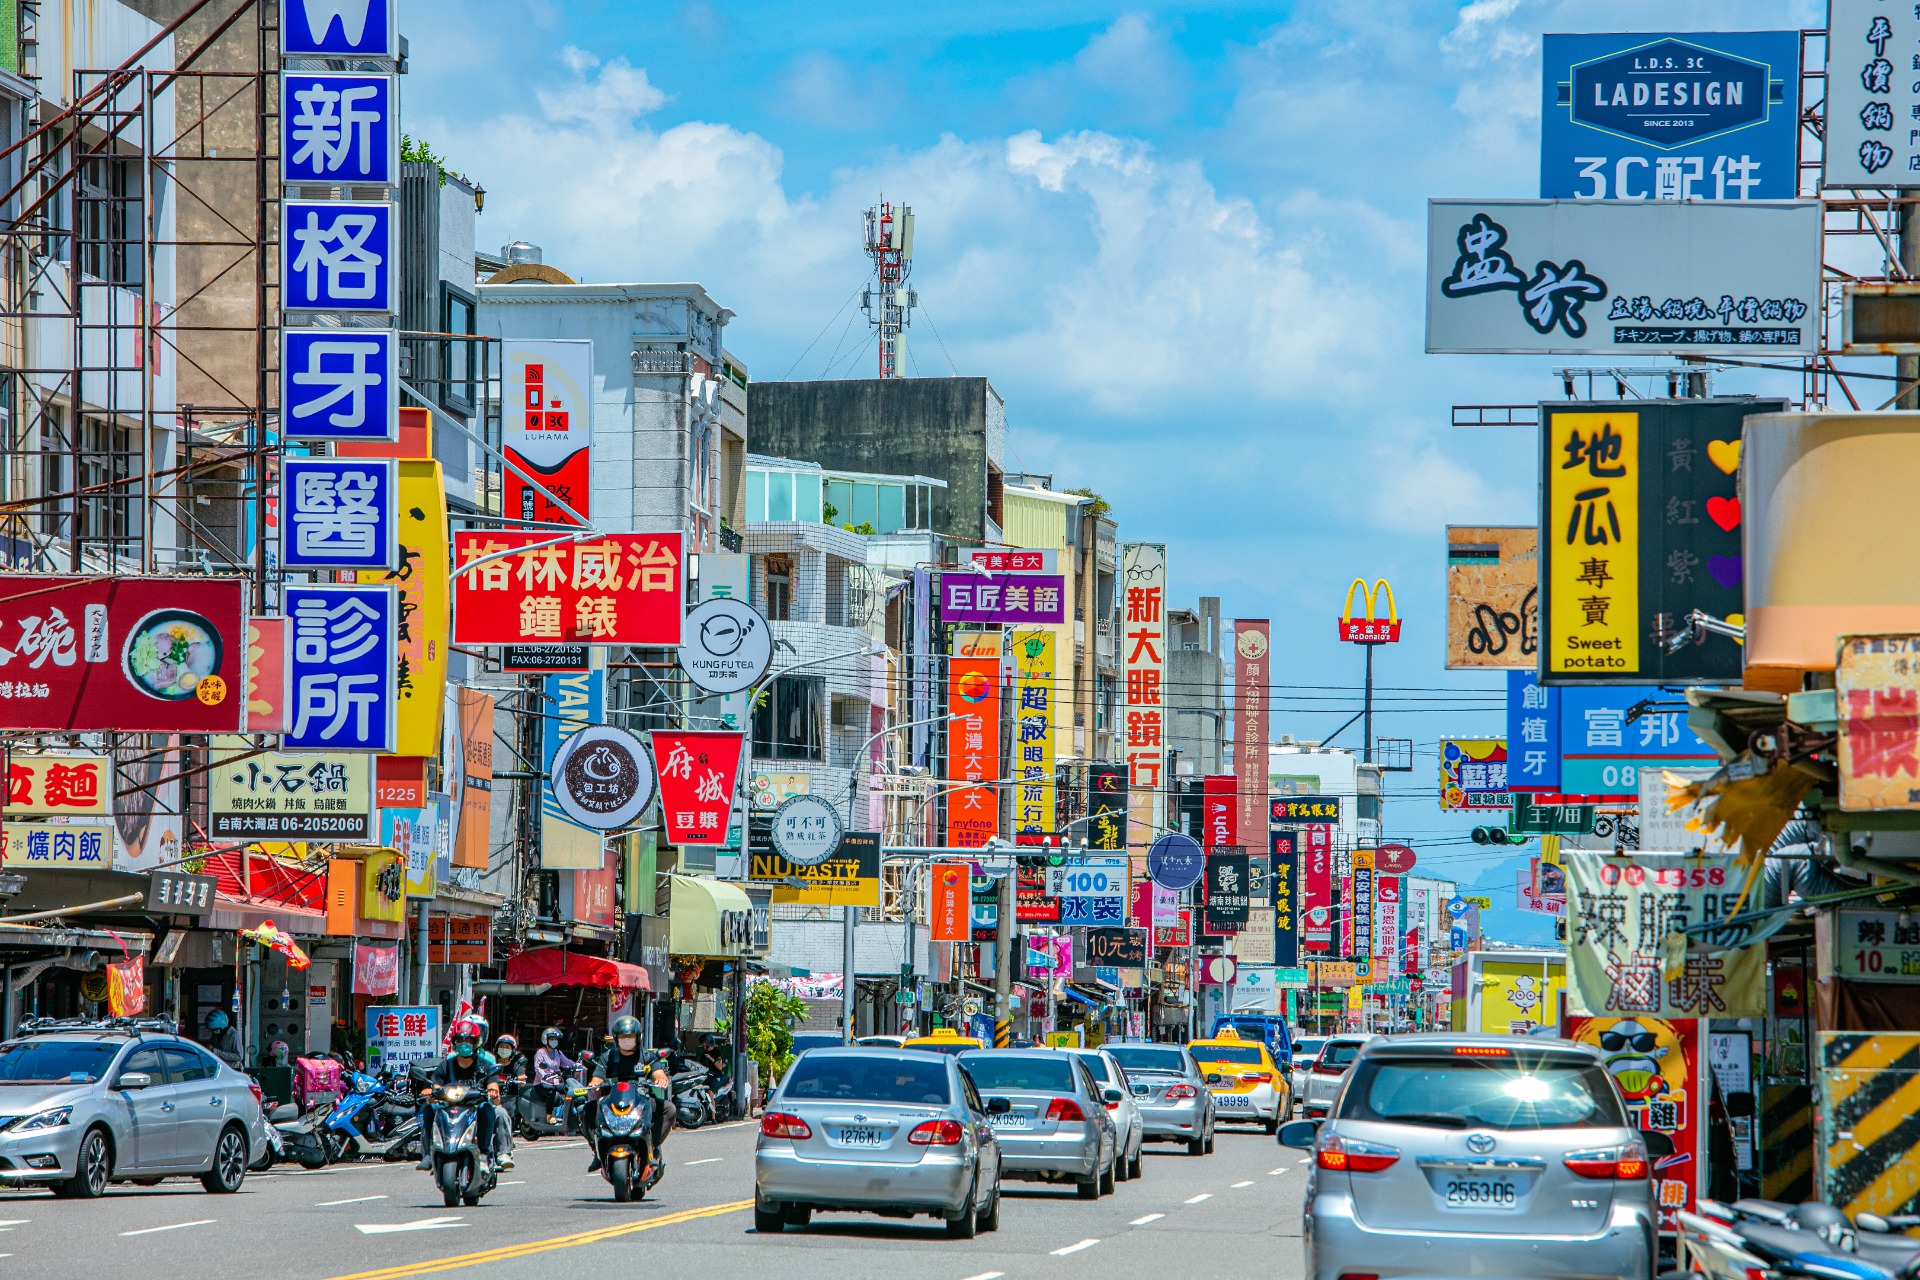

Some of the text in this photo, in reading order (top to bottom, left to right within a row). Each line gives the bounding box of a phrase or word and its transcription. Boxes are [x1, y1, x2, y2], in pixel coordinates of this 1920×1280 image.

[1634, 57, 1704, 69] L.D.S. 3C
[1595, 82, 1743, 107] LADESIGN
[1860, 16, 1893, 174] 平價鍋物
[1574, 156, 1762, 199] 3C配件
[292, 84, 382, 742] 新格牙醫診所
[1562, 422, 1627, 627] 地瓜專賣
[461, 539, 677, 592] 格林威治
[947, 585, 1059, 612] 巨匠美語
[519, 595, 618, 638] 鐘錶
[0, 607, 77, 669] 碗
[1567, 637, 1622, 650] Sweet
[511, 655, 582, 665] FAX:06-2720131
[693, 660, 755, 670] KUNG FU TEA
[1564, 655, 1626, 669] potato
[1127, 586, 1161, 787] 新大眼鏡行
[1520, 671, 1548, 776] 創植牙
[231, 760, 350, 795] 小石鍋
[313, 797, 347, 811] 烏龍麵
[378, 787, 416, 801] 1225
[676, 811, 718, 829] 豆漿
[1287, 802, 1338, 818] 寶島眼鏡
[218, 816, 364, 832] 台南大灣店 06-2052060
[786, 816, 827, 829] 可不可
[953, 819, 992, 829] myfone
[786, 831, 827, 841] 熟成紅茶
[753, 855, 791, 877] NU
[1654, 866, 1727, 888] 1358
[1277, 863, 1292, 931] 寶島眼鏡
[1089, 934, 1128, 959] 10元
[1854, 950, 1882, 973] 10
[376, 1013, 427, 1038] 佳鮮
